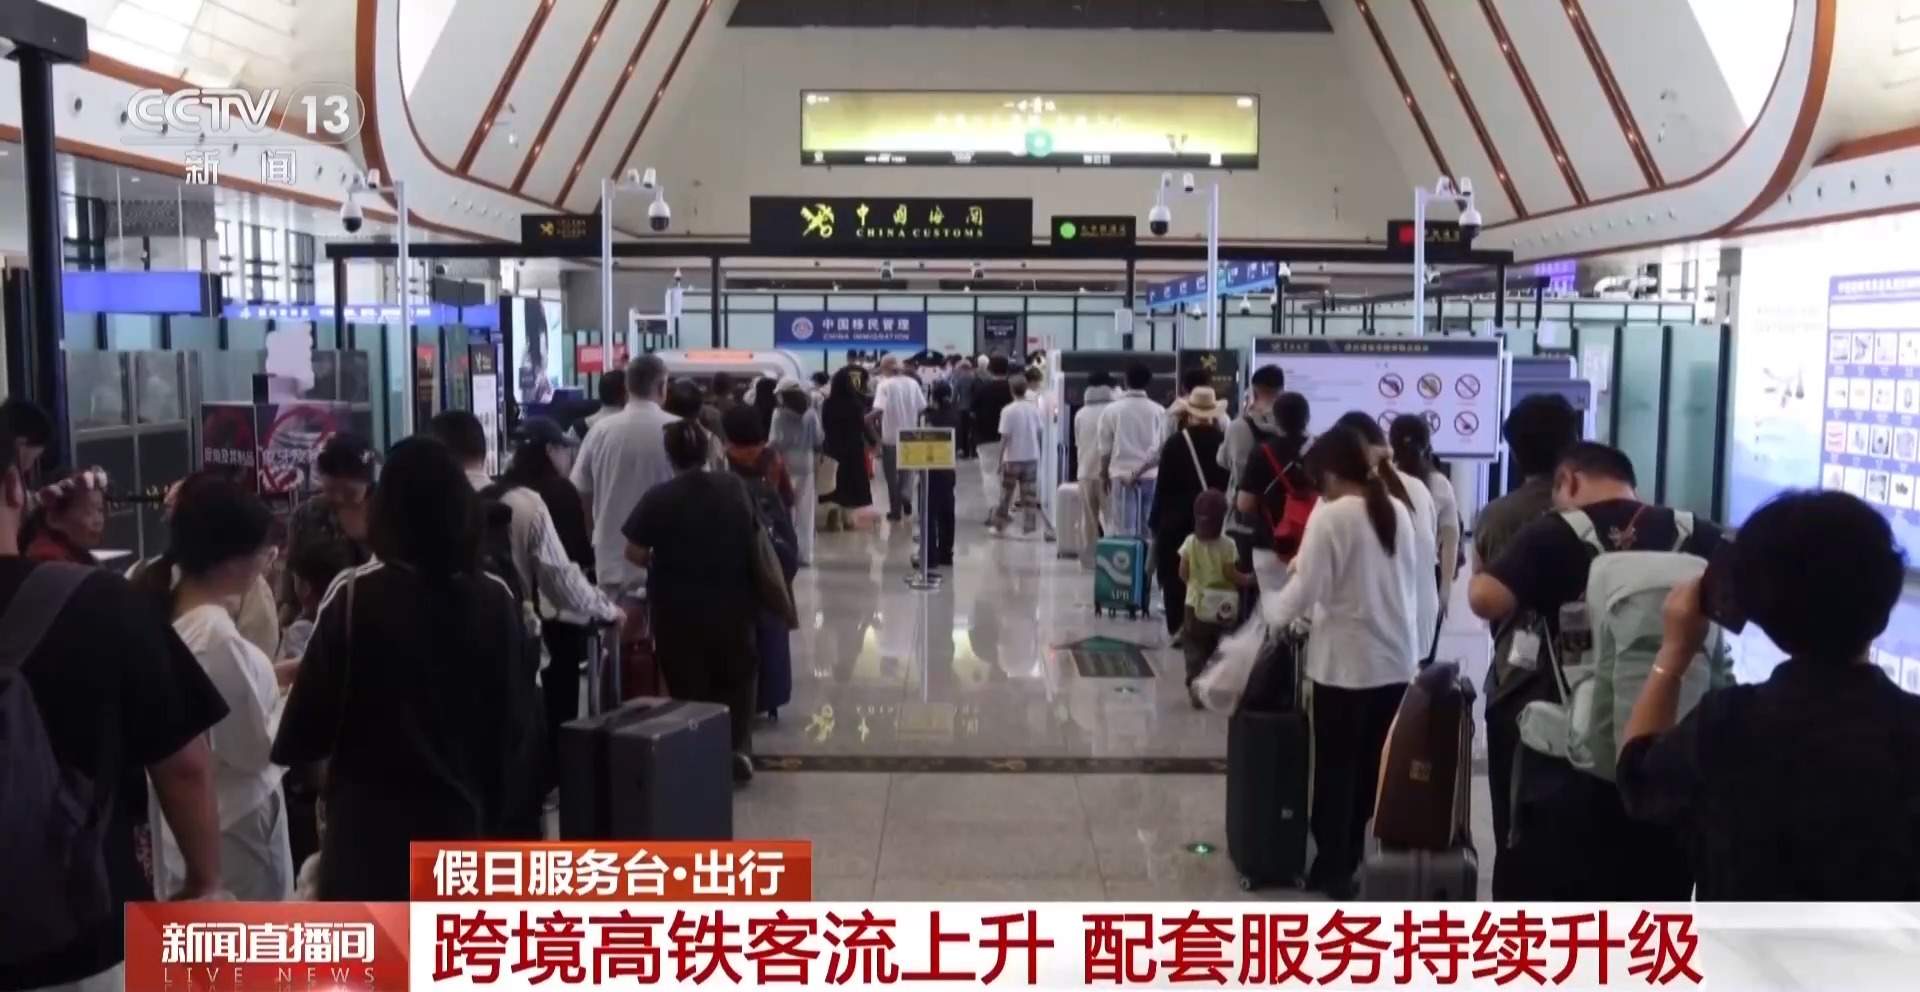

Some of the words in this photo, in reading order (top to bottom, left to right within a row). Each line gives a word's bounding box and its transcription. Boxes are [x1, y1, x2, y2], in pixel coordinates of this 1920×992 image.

[856, 227, 906, 238] CHINA
[912, 227, 984, 238] CUSTOMS
[822, 317, 910, 331] 中国移民管理
[822, 332, 850, 341] CHINA
